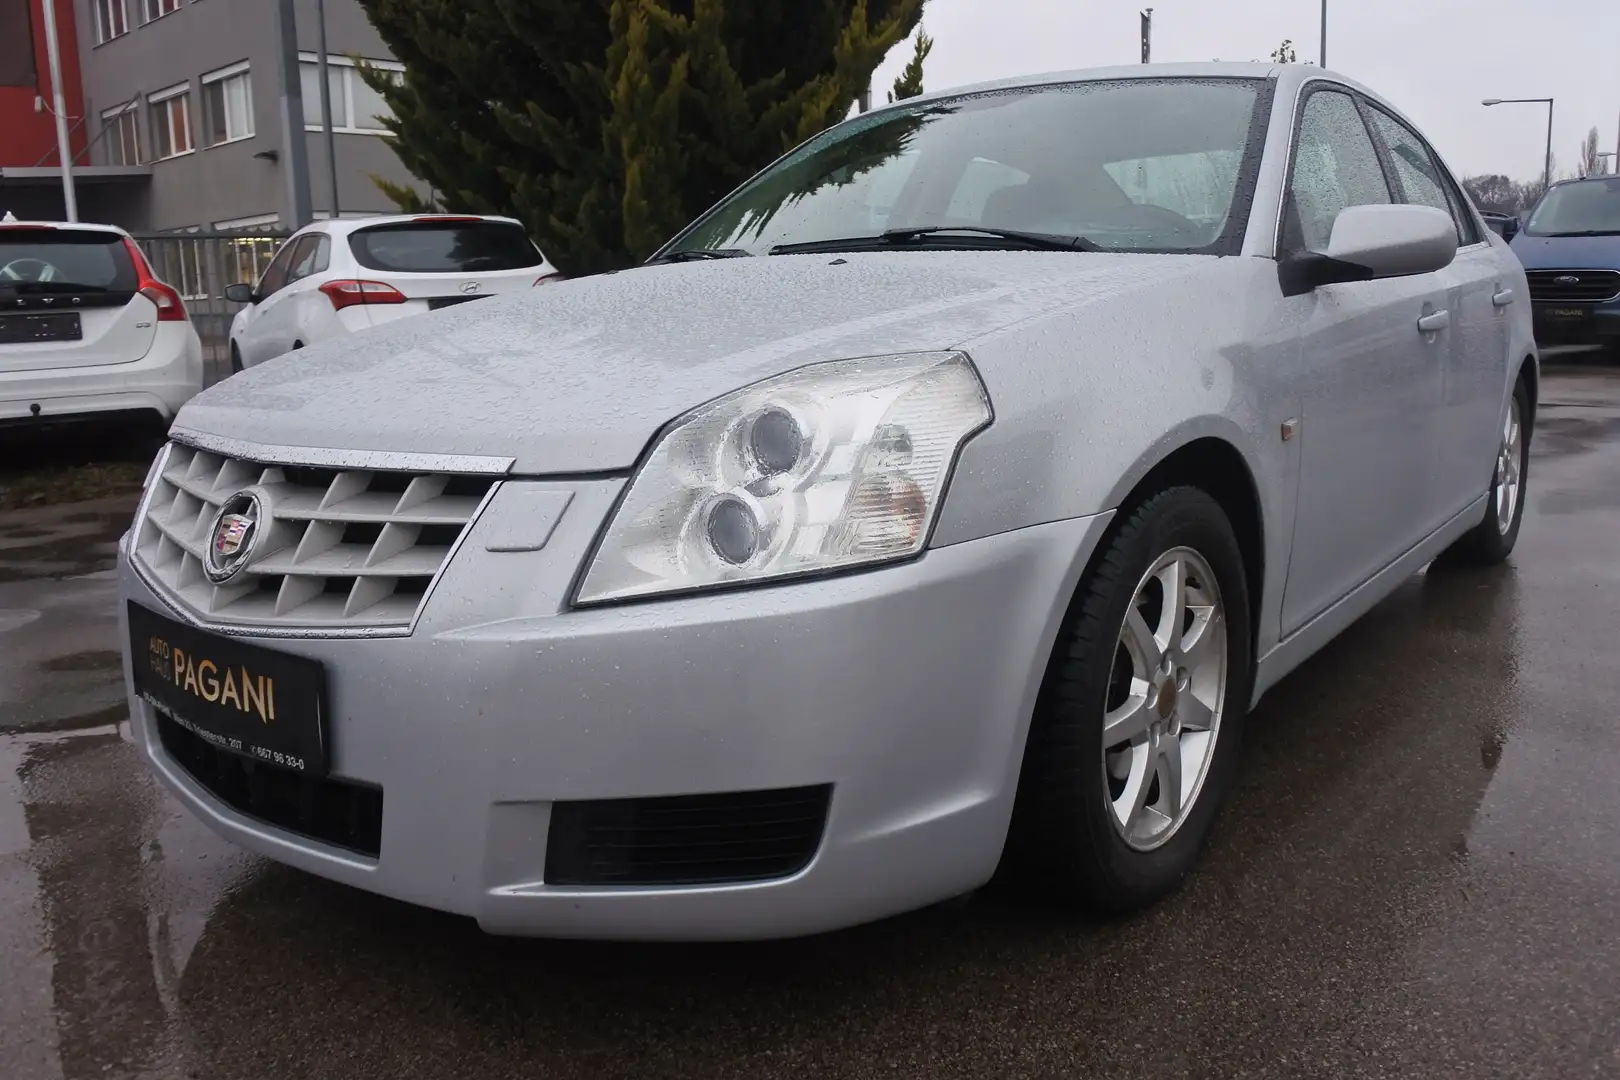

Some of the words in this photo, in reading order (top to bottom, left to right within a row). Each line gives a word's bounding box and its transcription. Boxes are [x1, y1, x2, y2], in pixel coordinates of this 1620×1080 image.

[150, 637, 169, 659] AUTO
[173, 647, 275, 724] PAGANI
[273, 751, 285, 764] 96
[285, 755, 305, 770] 33-0
